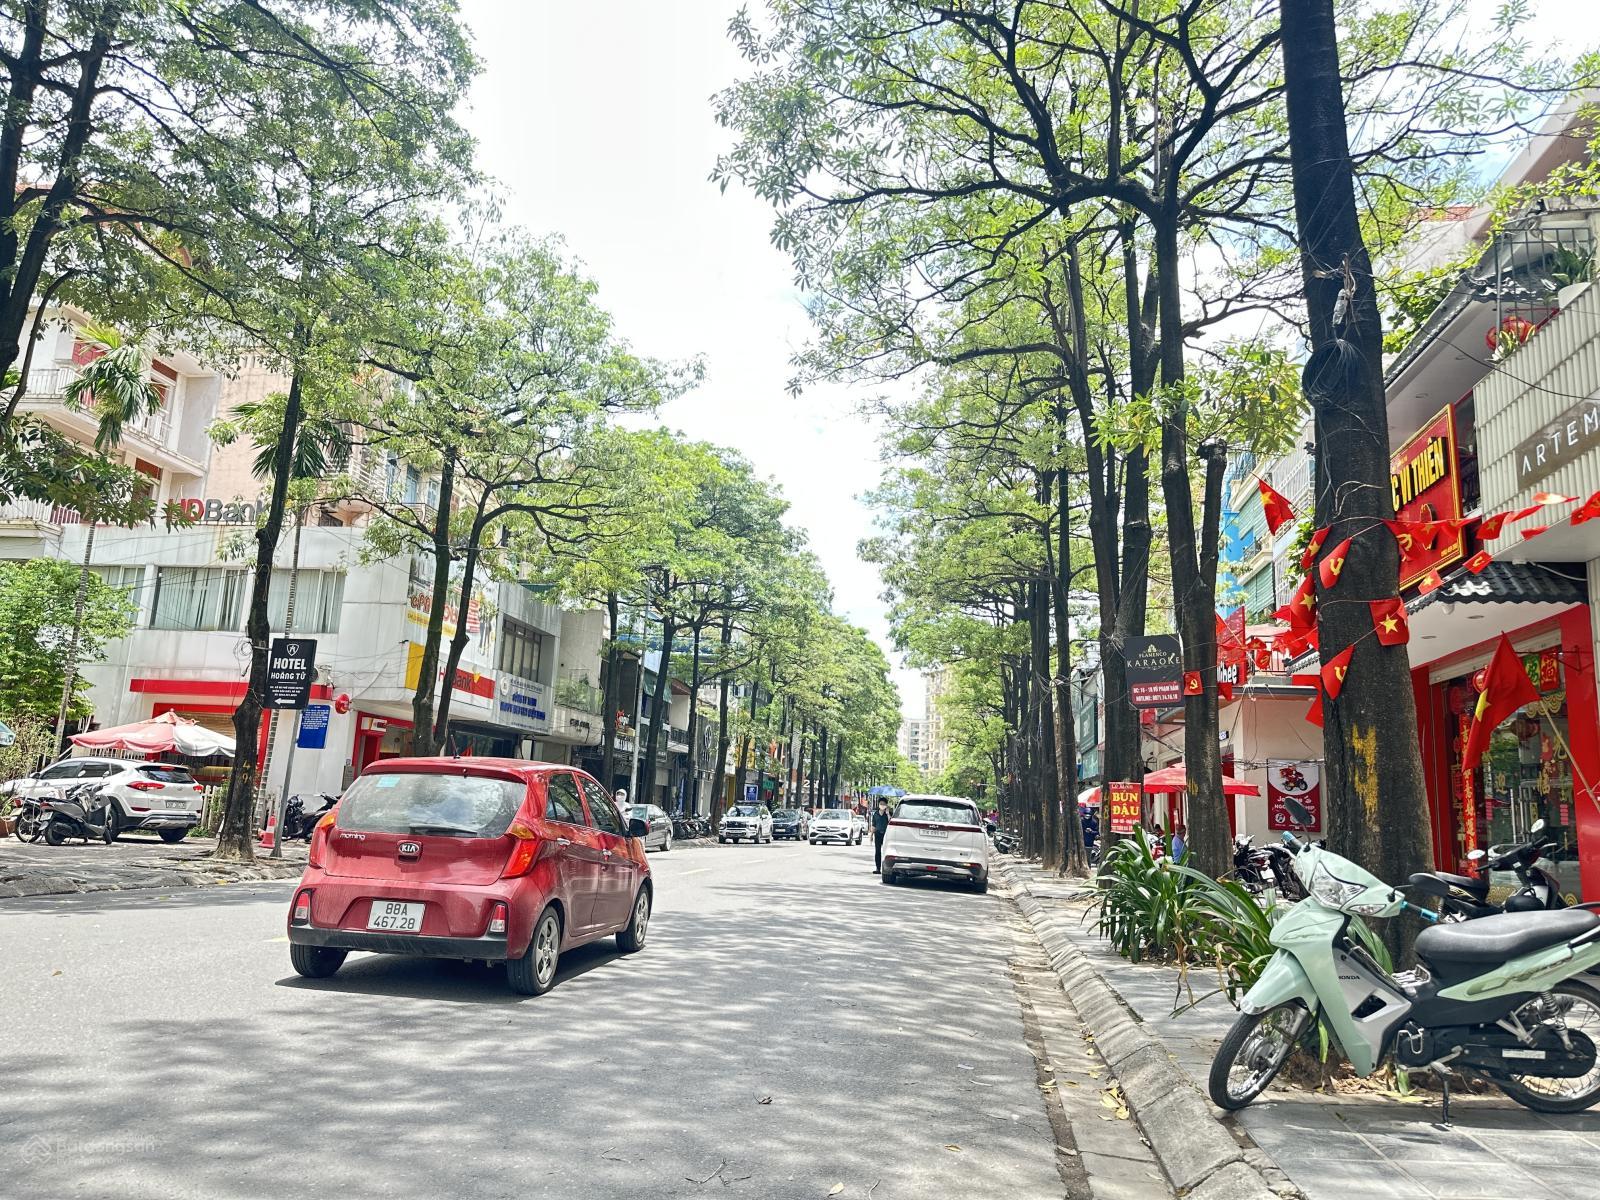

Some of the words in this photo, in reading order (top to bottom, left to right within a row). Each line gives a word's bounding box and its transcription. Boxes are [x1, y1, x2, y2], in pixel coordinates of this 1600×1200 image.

[1411, 438, 1445, 497] THIÊN
[273, 657, 307, 670] HOTEL
[1127, 653, 1180, 668] KARAOKE
[438, 666, 472, 691] HBank
[1112, 790, 1139, 802] BÚN
[1112, 803, 1140, 818] ĐẬU
[401, 844, 417, 852] KIA
[385, 902, 408, 915] 88A
[373, 916, 416, 929] 467.28
